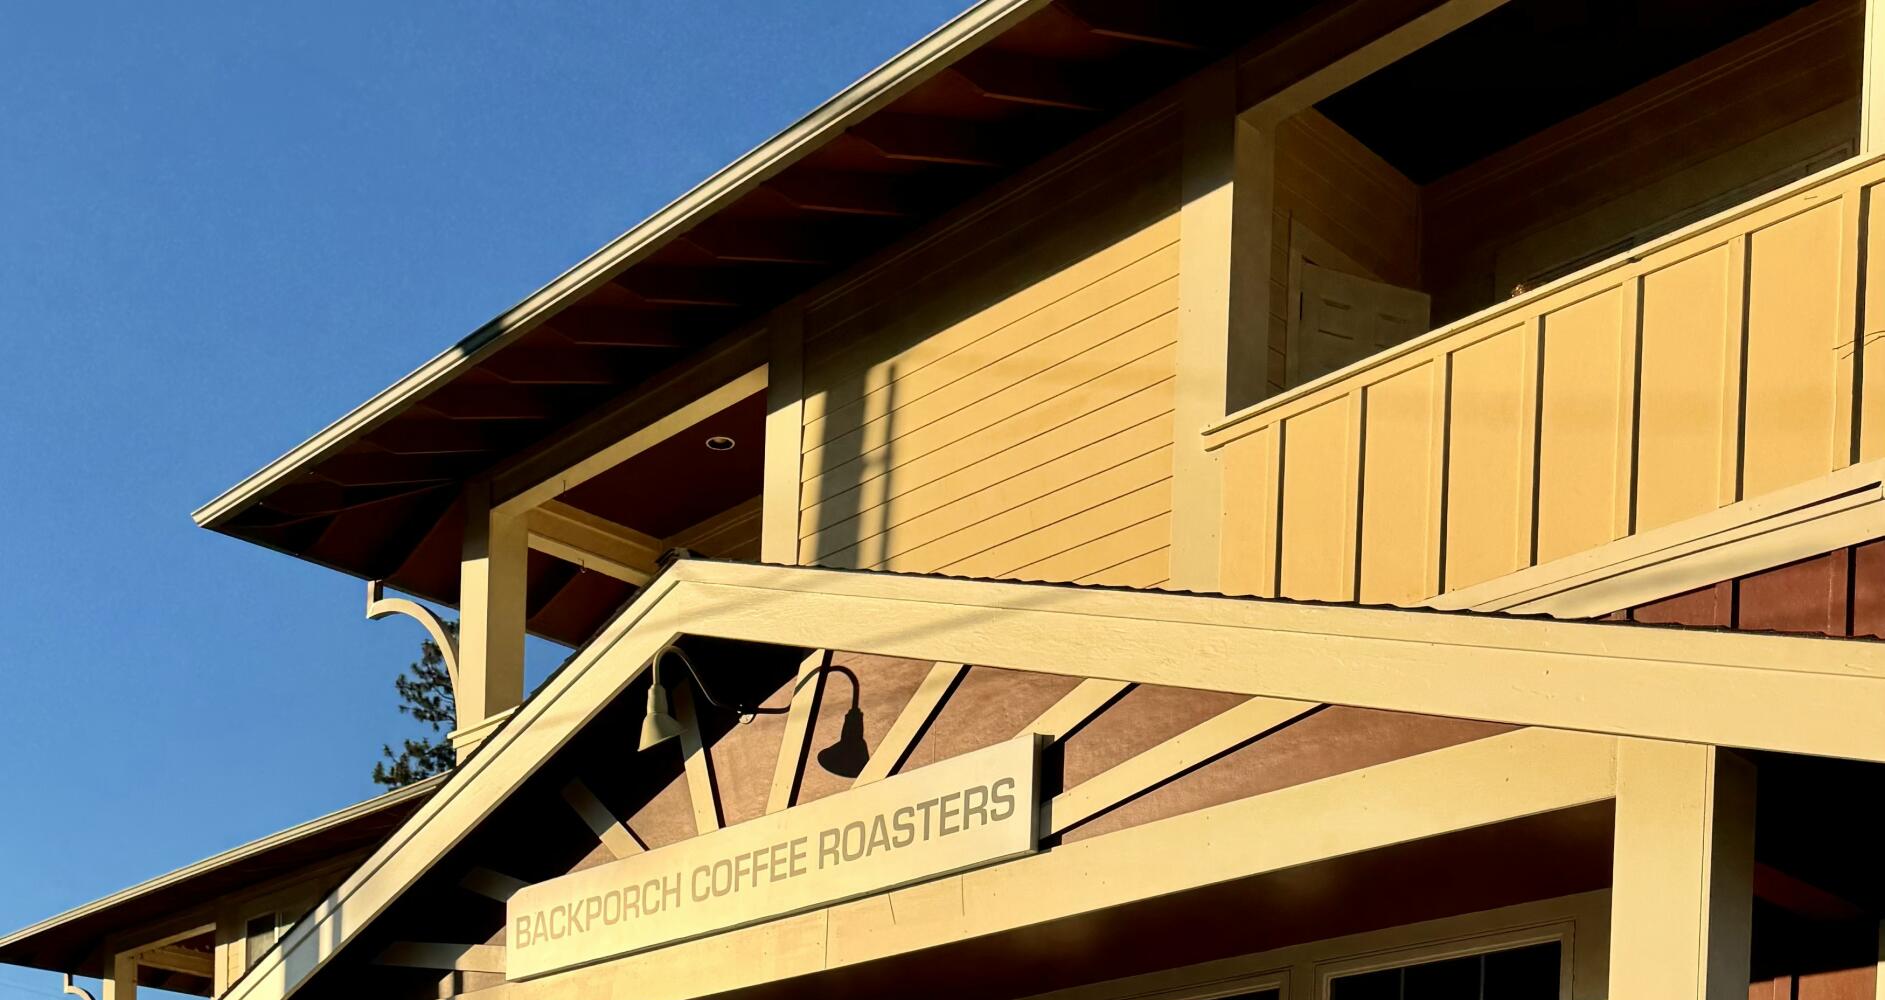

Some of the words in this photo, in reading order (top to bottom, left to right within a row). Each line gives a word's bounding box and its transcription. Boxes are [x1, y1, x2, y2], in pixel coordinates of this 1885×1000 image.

[515, 871, 682, 949] BACKPORCH
[691, 836, 808, 903] COFFEE
[818, 777, 1015, 869] ROASTERS
